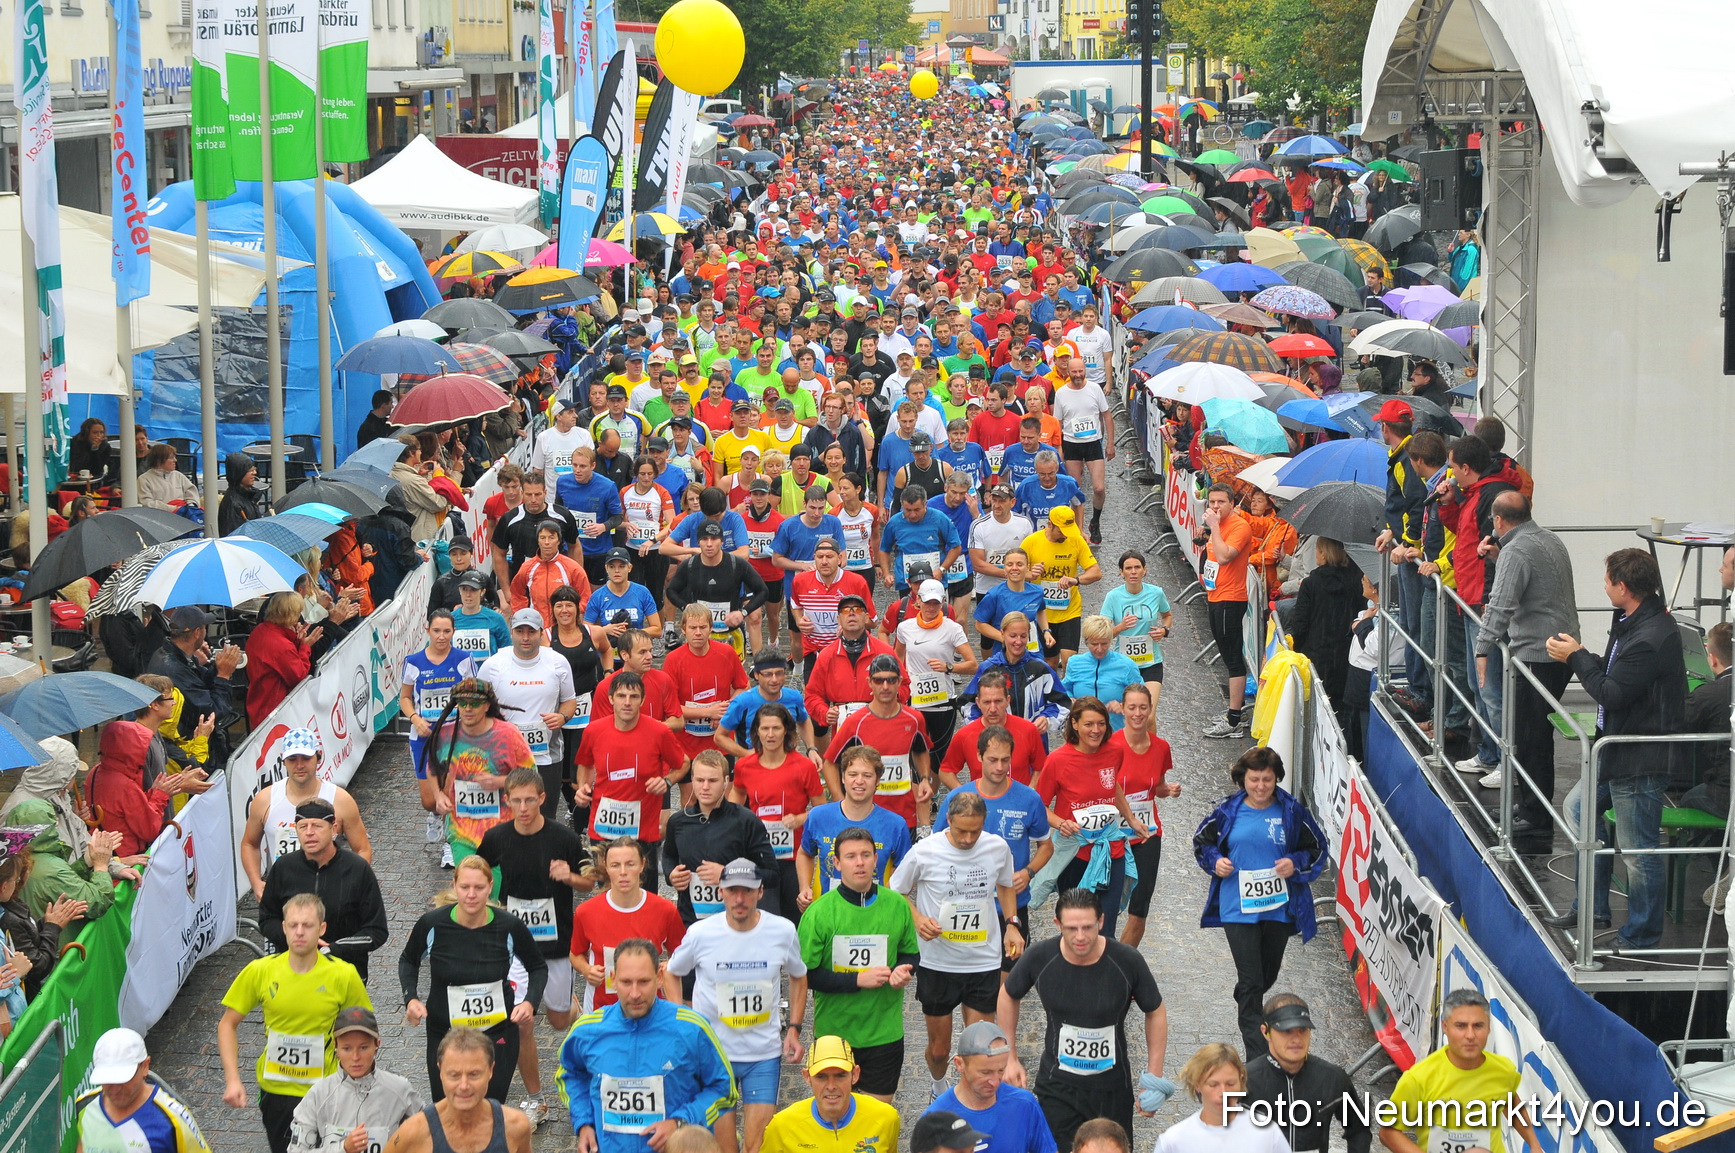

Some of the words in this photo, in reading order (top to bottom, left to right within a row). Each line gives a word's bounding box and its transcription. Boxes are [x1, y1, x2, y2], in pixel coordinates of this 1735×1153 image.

[574, 166, 598, 186] maxi
[1074, 421, 1095, 432] 3371
[555, 457, 572, 466] 255
[1044, 588, 1068, 599] 2225
[456, 637, 486, 650] 3396
[1126, 643, 1147, 655] 358
[917, 680, 940, 695] 339
[424, 695, 448, 709] 315
[459, 791, 495, 806] 2184
[599, 810, 635, 826] 3051
[1244, 877, 1284, 898] 2930
[950, 913, 980, 930] 174
[949, 932, 979, 941] Christian
[849, 948, 871, 967] 29
[461, 995, 494, 1016] 439
[729, 995, 762, 1013] 118
[1064, 1038, 1110, 1058] 3286
[277, 1047, 311, 1065] 251
[606, 1091, 656, 1112] 2561
[620, 1115, 644, 1125] Heiko
